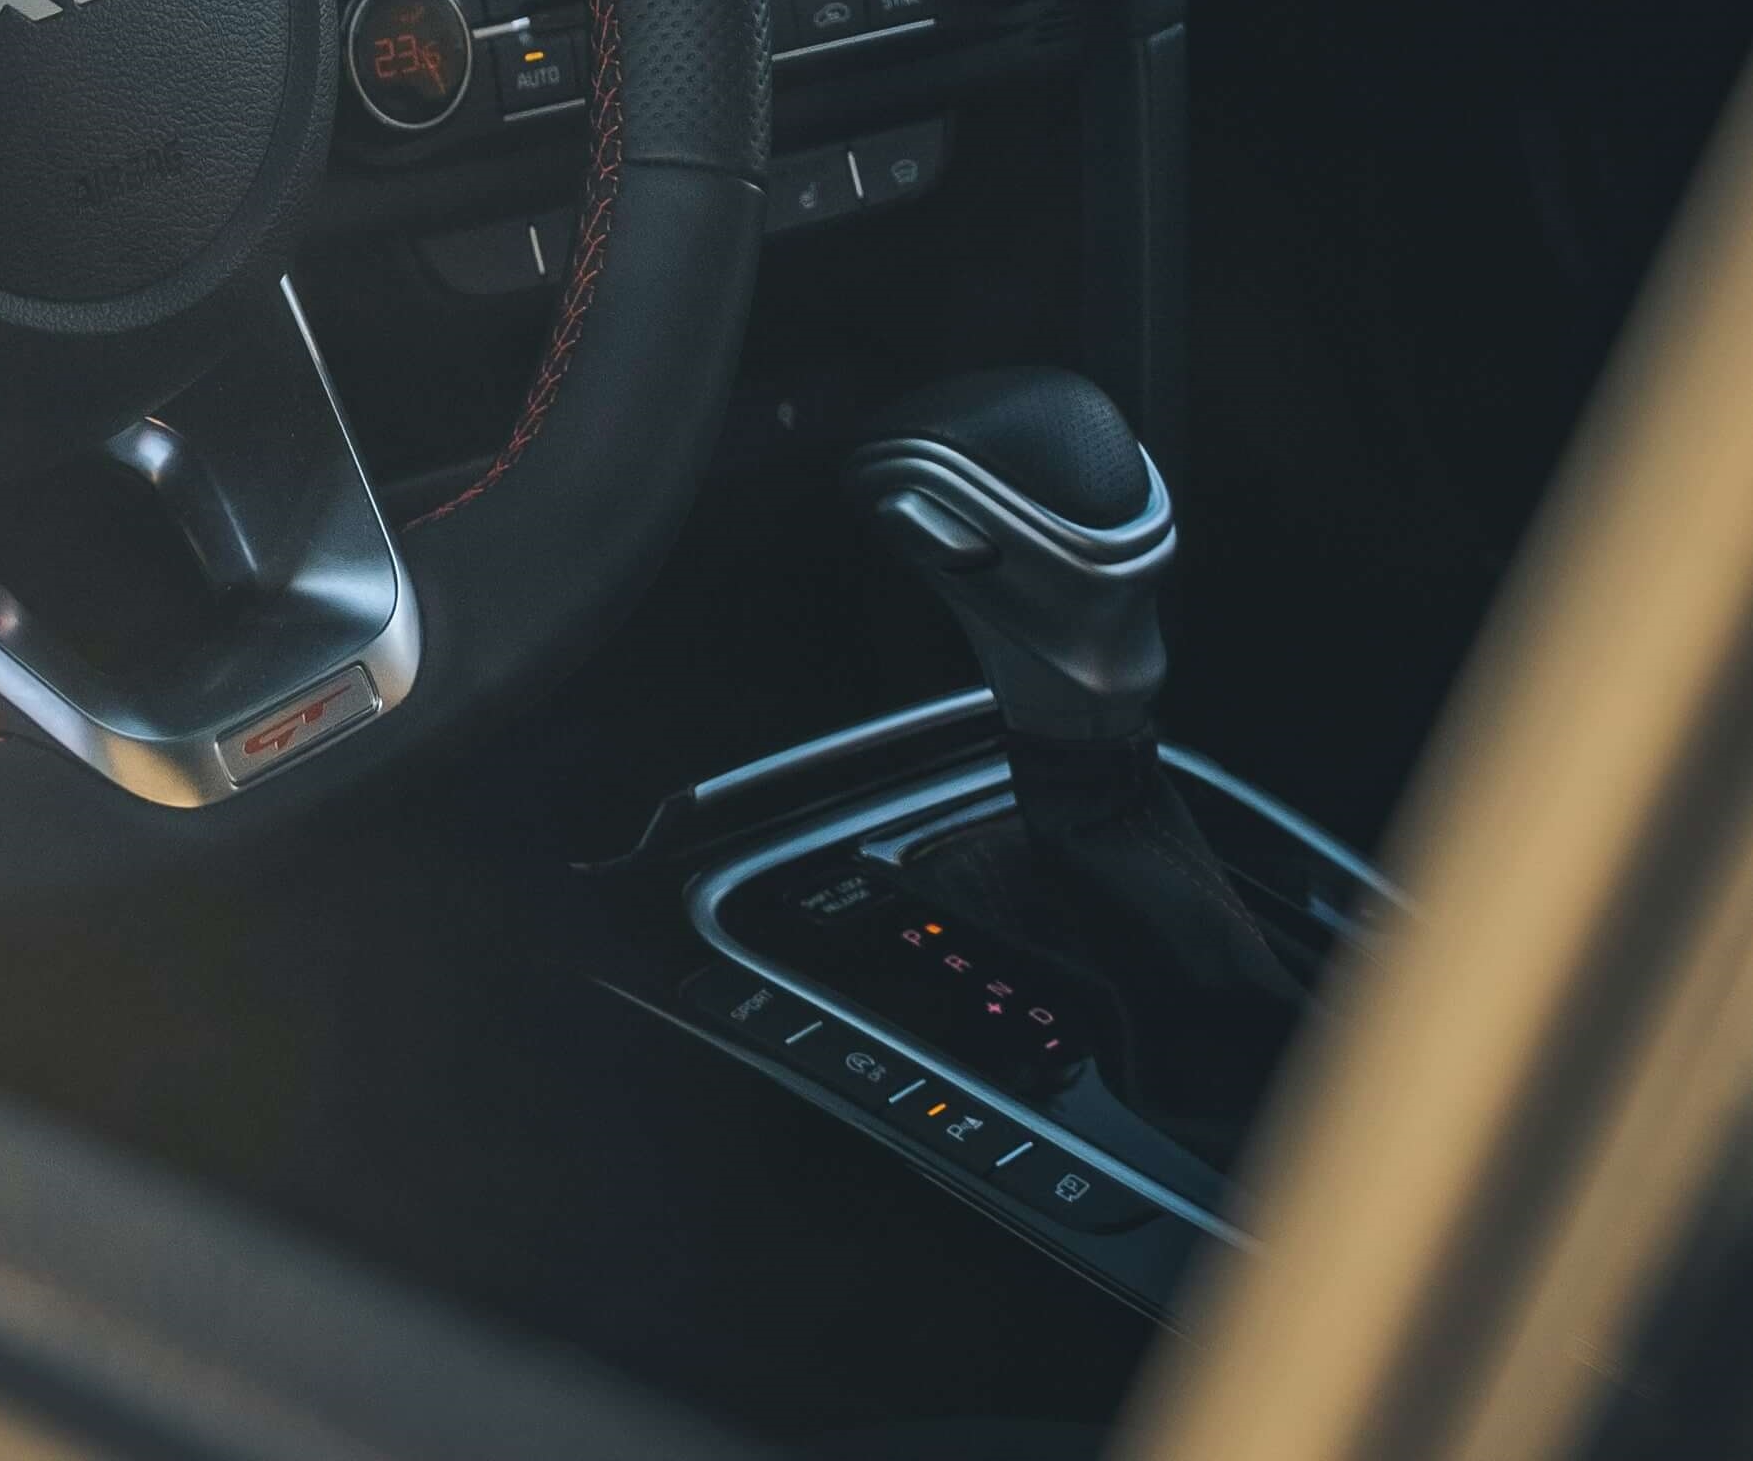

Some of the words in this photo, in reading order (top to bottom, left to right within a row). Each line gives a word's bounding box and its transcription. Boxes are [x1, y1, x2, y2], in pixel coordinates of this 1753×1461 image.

[517, 64, 560, 91] AUTO
[901, 929, 922, 947] P
[944, 954, 973, 973] R
[1028, 1007, 1054, 1025] D
